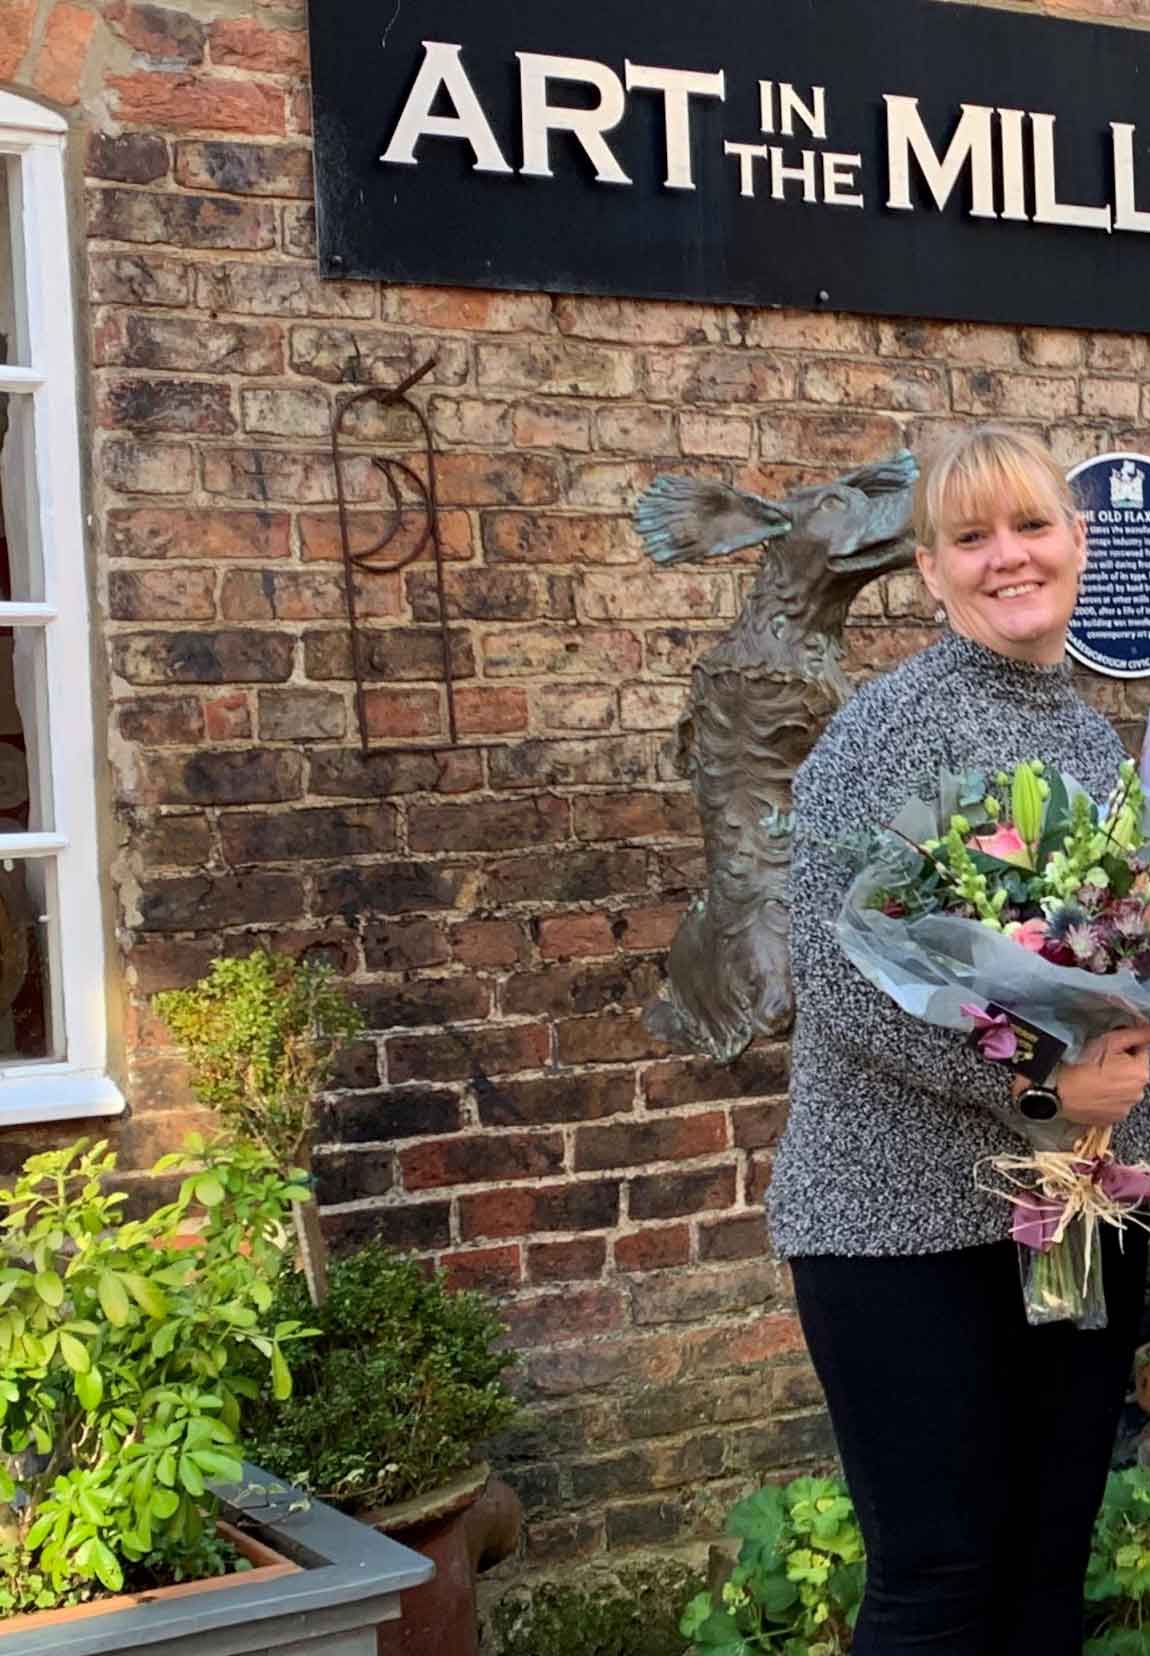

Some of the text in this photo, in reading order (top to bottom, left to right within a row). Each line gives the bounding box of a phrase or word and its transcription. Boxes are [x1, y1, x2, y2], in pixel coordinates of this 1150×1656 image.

[378, 40, 725, 190] ART
[758, 80, 827, 139] IN
[723, 140, 864, 208] THE
[1098, 510, 1122, 523] OLD
